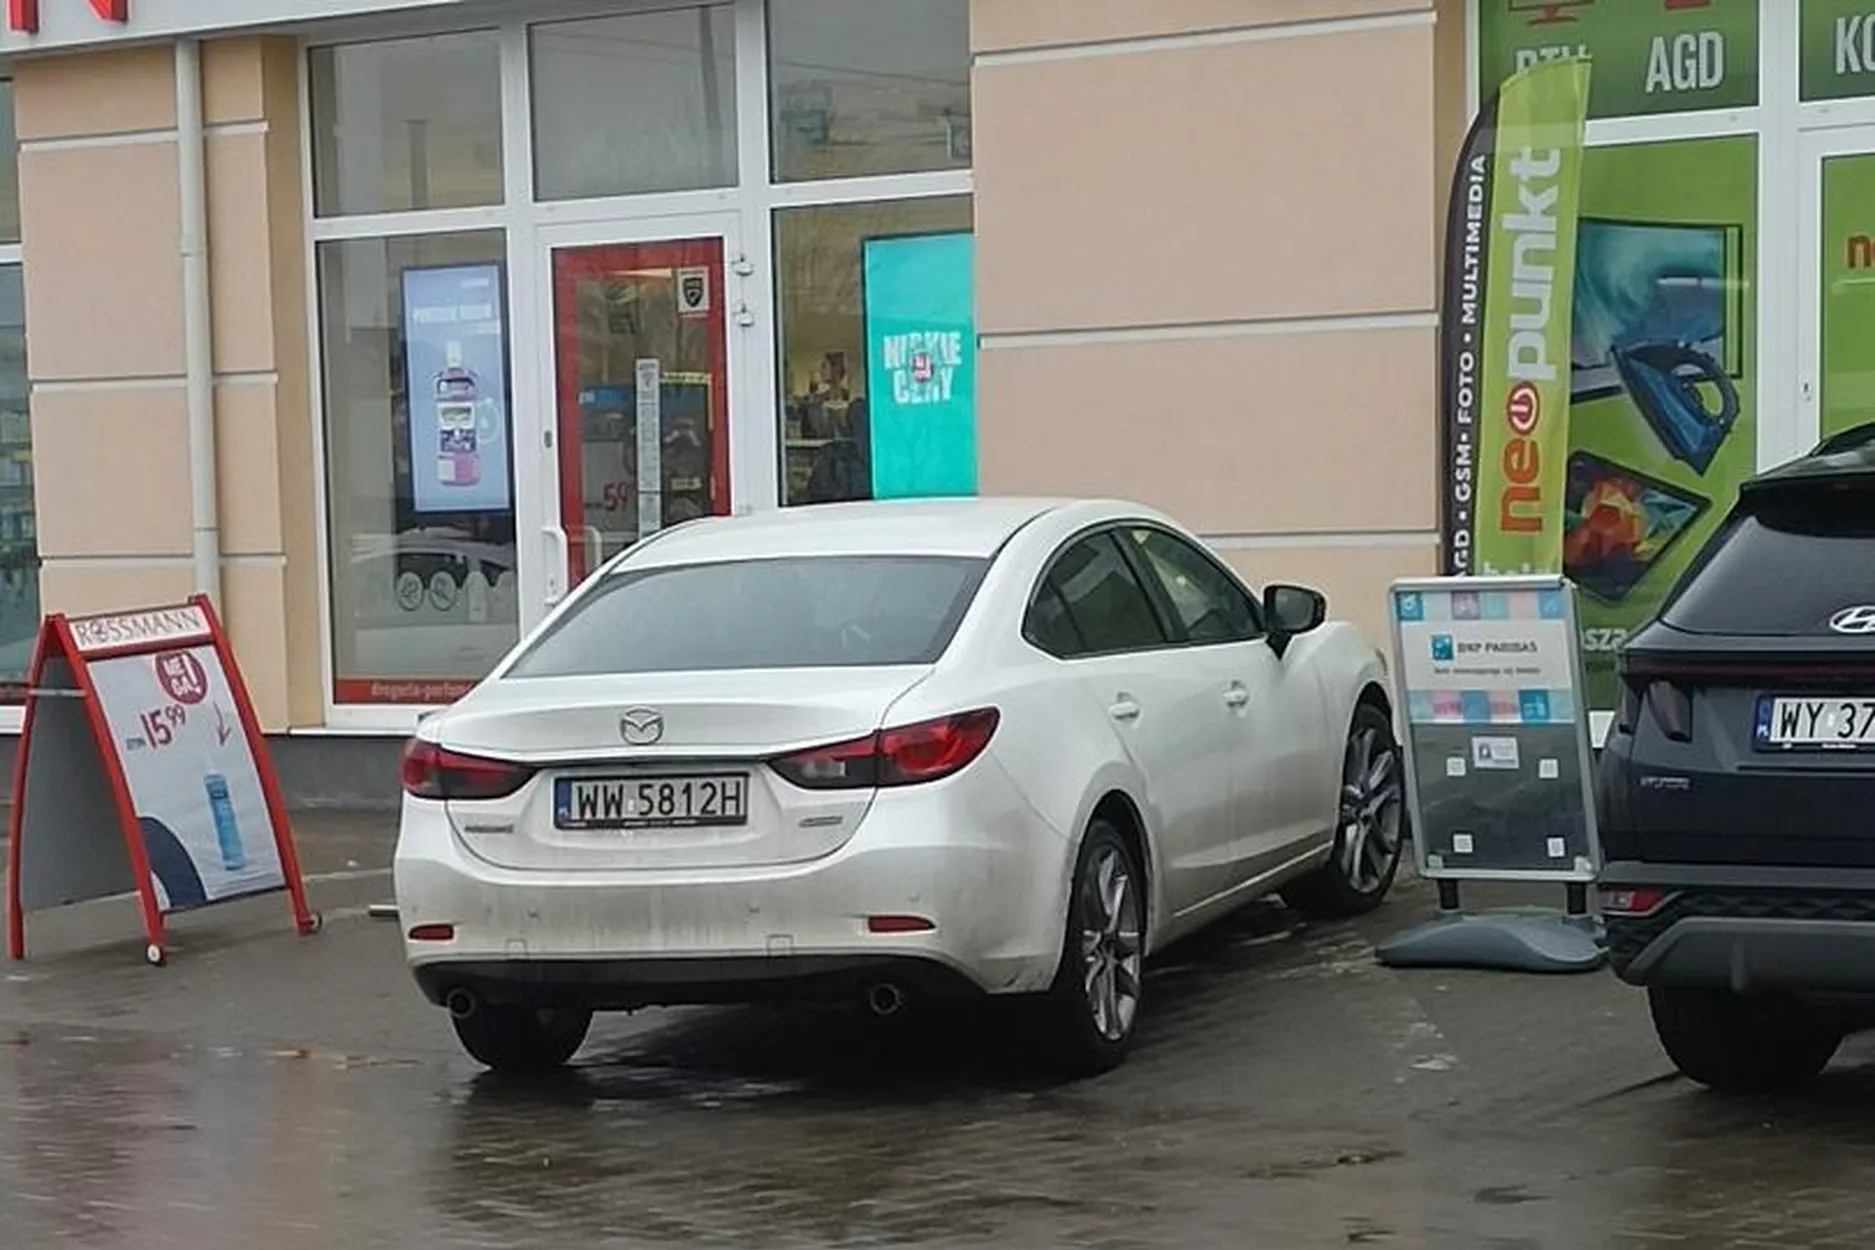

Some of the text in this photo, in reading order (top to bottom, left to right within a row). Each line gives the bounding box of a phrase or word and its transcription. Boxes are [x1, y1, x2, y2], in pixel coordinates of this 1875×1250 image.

[1645, 31, 1724, 93] AGD
[1461, 154, 1486, 325] MULTIMEDIA
[1457, 353, 1474, 424] FOTO
[1455, 443, 1473, 502] GSM
[75, 609, 202, 647] ROSSMANN
[1780, 702, 1825, 738] WY
[1838, 702, 1875, 738] 37
[577, 781, 741, 818] WW 5812H
